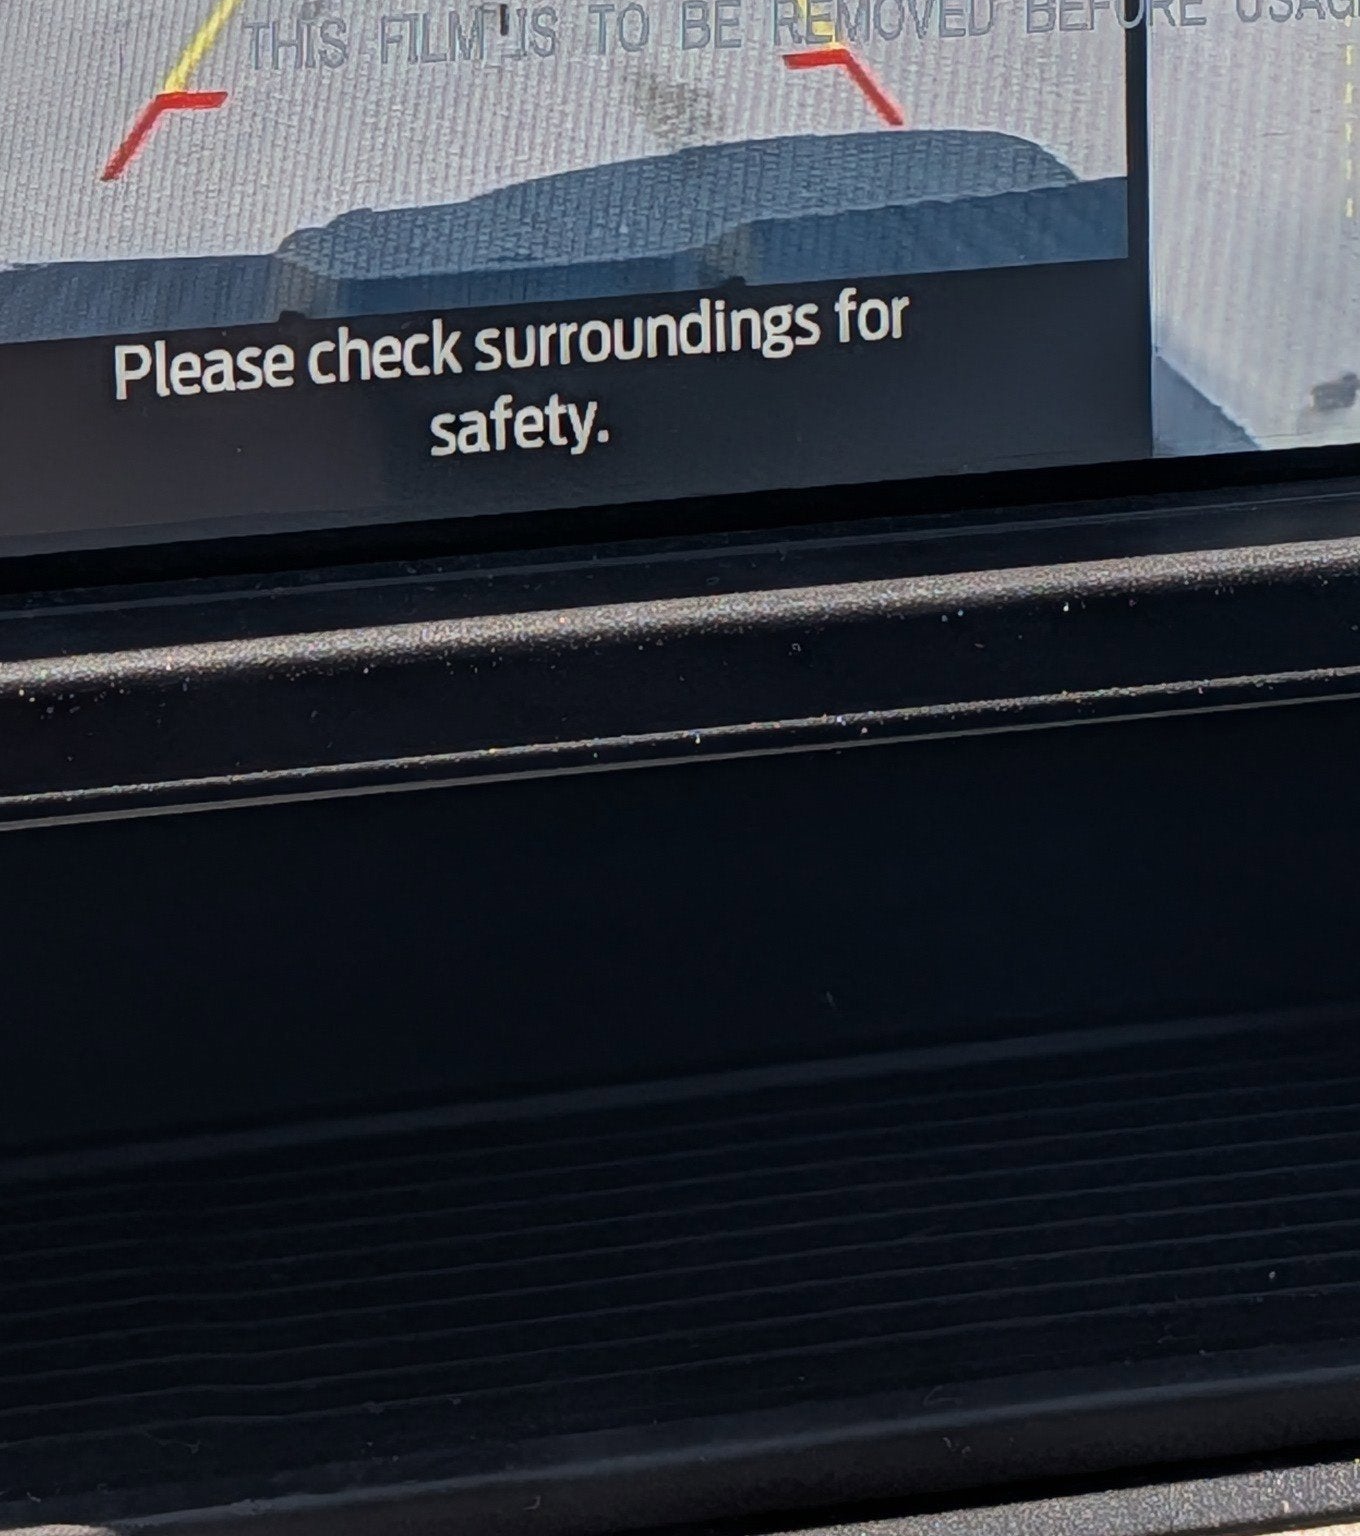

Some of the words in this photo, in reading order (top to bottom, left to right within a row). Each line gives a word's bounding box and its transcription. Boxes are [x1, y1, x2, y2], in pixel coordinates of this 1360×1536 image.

[244, 16, 349, 70] THIS
[380, 10, 486, 65] FILM
[514, 5, 559, 58] IS
[590, 2, 650, 54] TO
[115, 339, 295, 400] Please
[308, 318, 463, 384] check
[474, 298, 821, 372] surroundings
[834, 287, 909, 343] for
[430, 393, 610, 456] safety.
